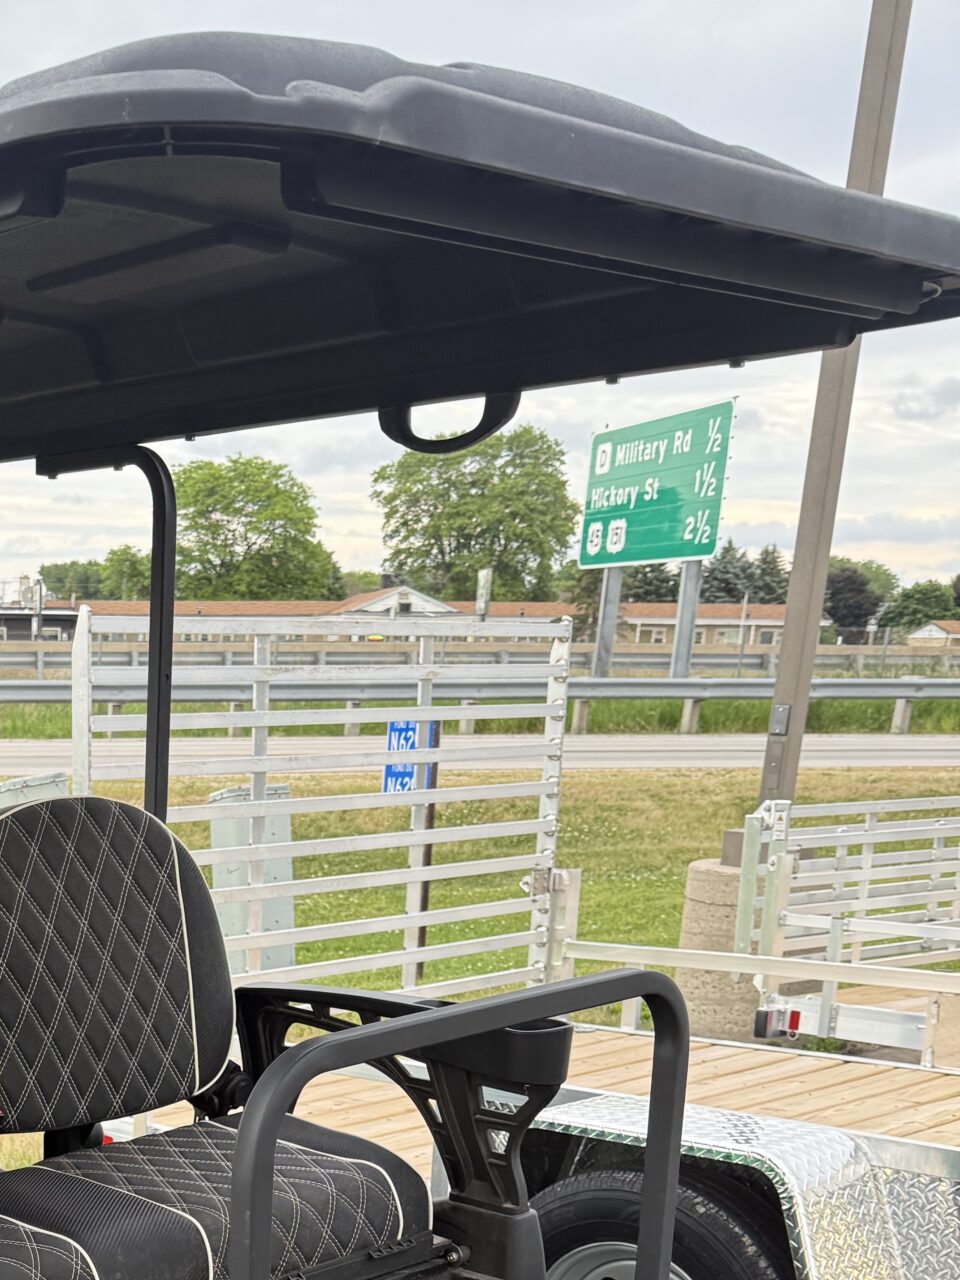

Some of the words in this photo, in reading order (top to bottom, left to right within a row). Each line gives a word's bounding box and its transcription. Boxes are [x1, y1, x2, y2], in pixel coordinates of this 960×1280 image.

[614, 438, 668, 466] Military
[673, 429, 692, 455] Rd
[591, 485, 639, 509] Hickory
[643, 477, 660, 501] St
[391, 731, 418, 751] N62
